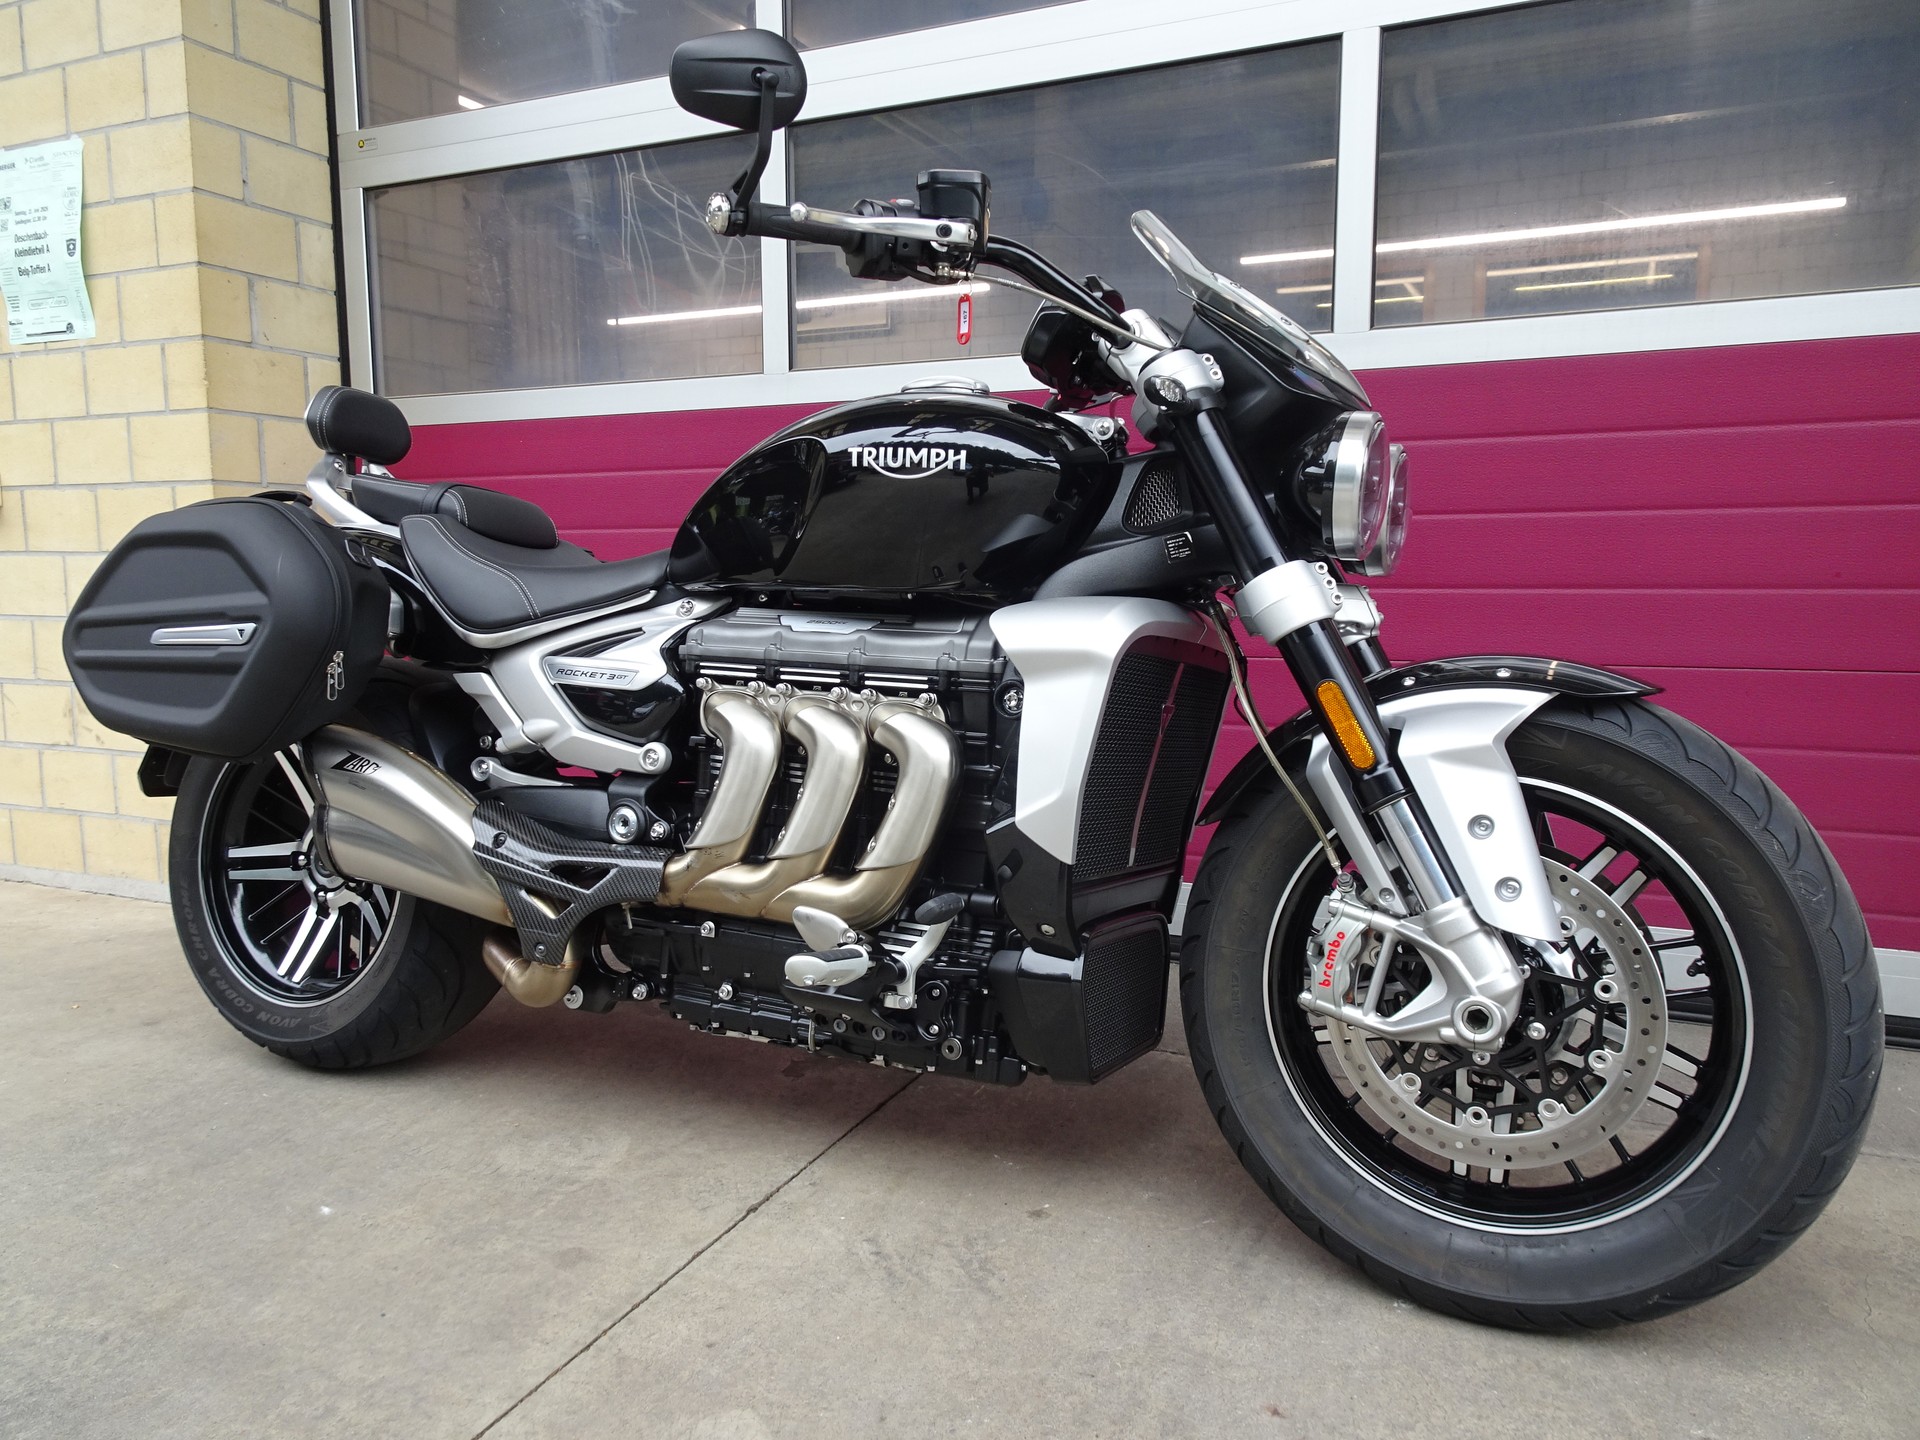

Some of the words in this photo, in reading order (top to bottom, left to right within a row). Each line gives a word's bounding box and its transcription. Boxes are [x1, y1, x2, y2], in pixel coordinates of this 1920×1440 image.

[847, 446, 967, 478] TRIUMPH
[1319, 931, 1346, 988] brembo
[207, 966, 255, 1014] COBRA
[256, 1010, 302, 1029] AVON
